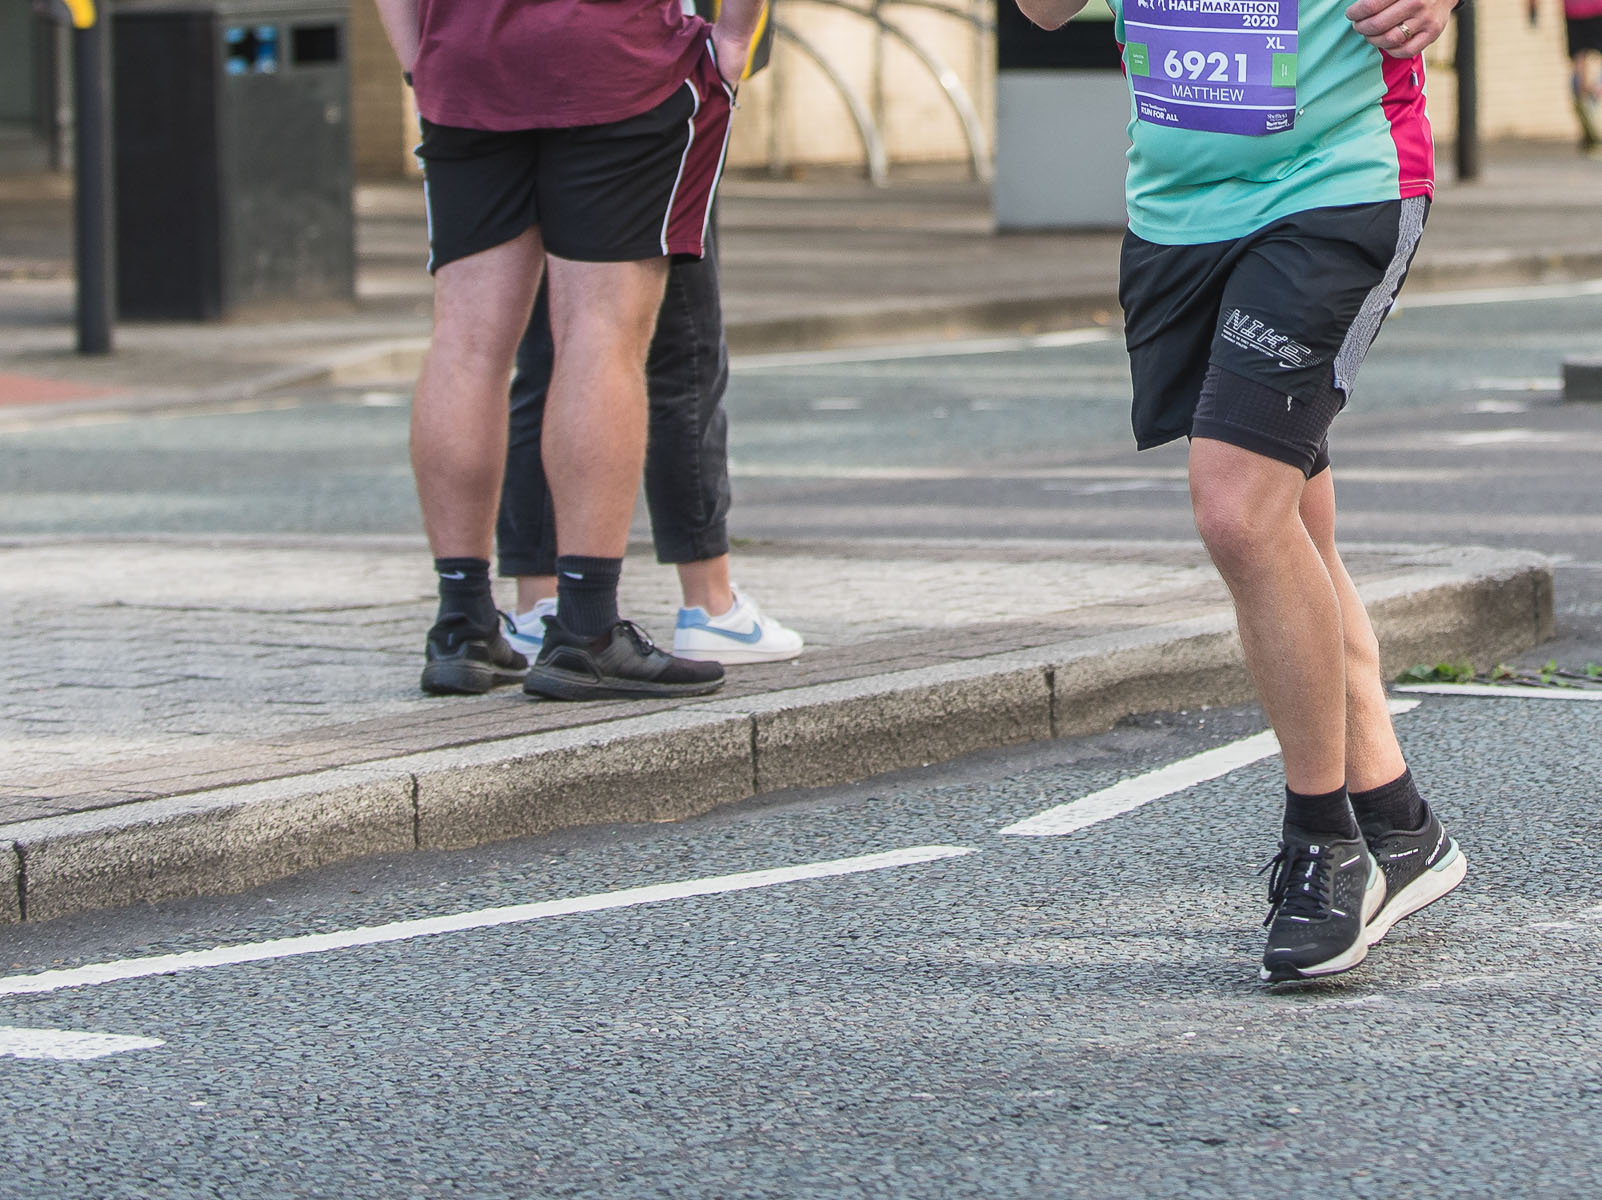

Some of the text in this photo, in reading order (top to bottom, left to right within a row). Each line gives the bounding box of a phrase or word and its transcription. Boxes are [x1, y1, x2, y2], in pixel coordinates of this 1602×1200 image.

[1168, 0, 1278, 14] HALF MARATHON
[1242, 15, 1278, 28] 2020
[1265, 36, 1286, 49] XL
[1163, 50, 1248, 83] 6921
[1172, 84, 1244, 102] MATTHEW
[1153, 110, 1165, 120] FOR
[1166, 113, 1179, 122] ALL
[1225, 308, 1312, 363] NIKE
